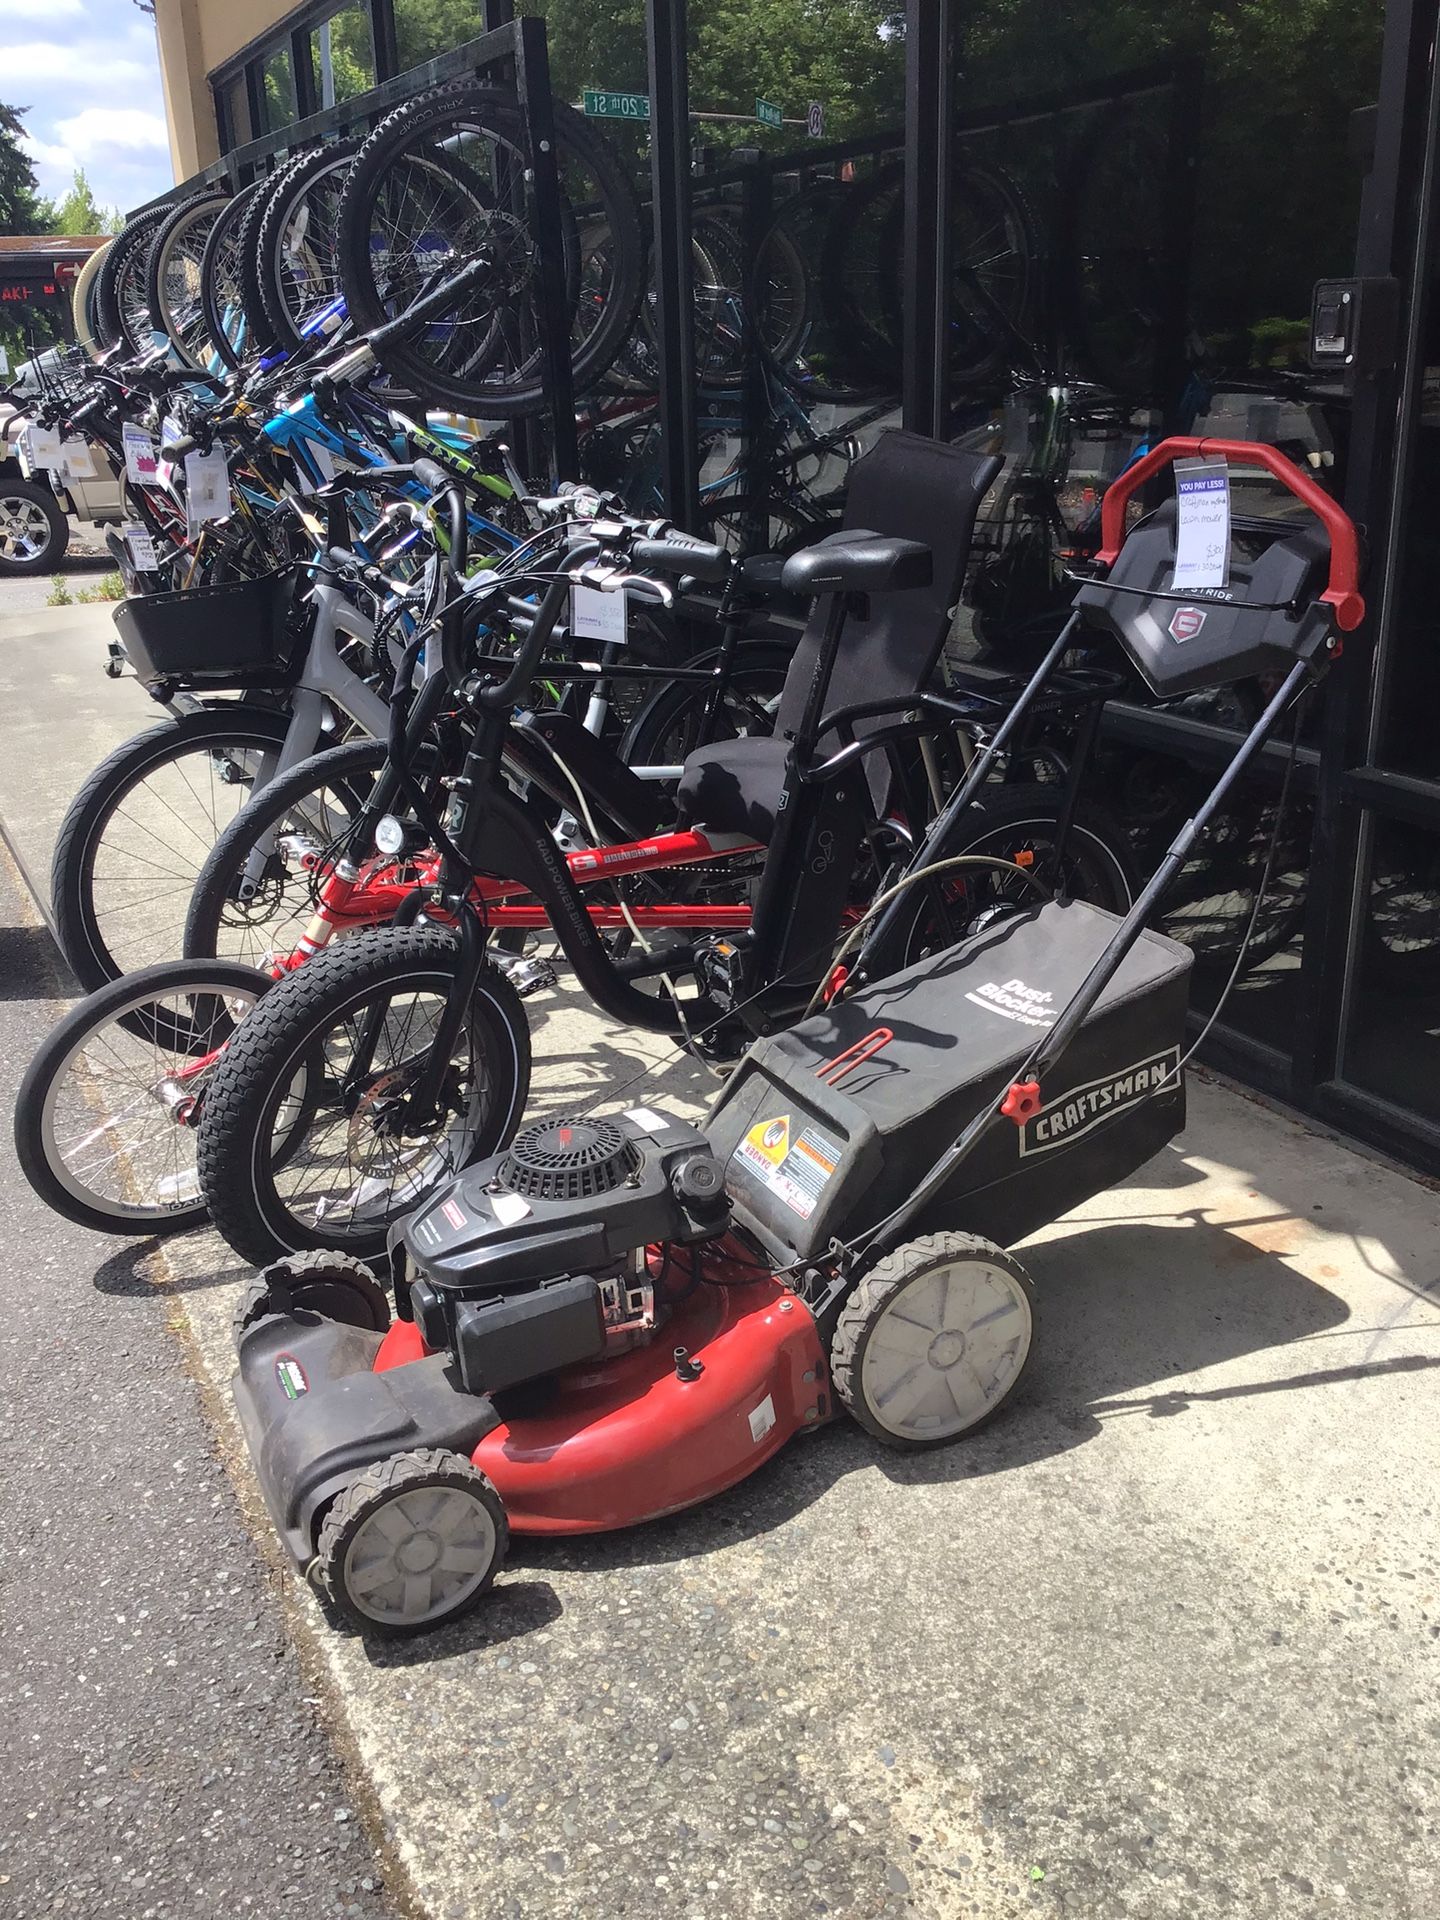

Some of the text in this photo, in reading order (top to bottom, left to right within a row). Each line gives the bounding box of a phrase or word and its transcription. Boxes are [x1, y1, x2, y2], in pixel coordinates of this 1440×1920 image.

[399, 109, 434, 136] COMP
[1180, 479, 1225, 491] YOU PAY LESS!
[536, 838, 592, 947] RAD POWER BIKES
[1035, 1061, 1167, 1141] CRAFTSMAN
[744, 1144, 772, 1171] DANGER
